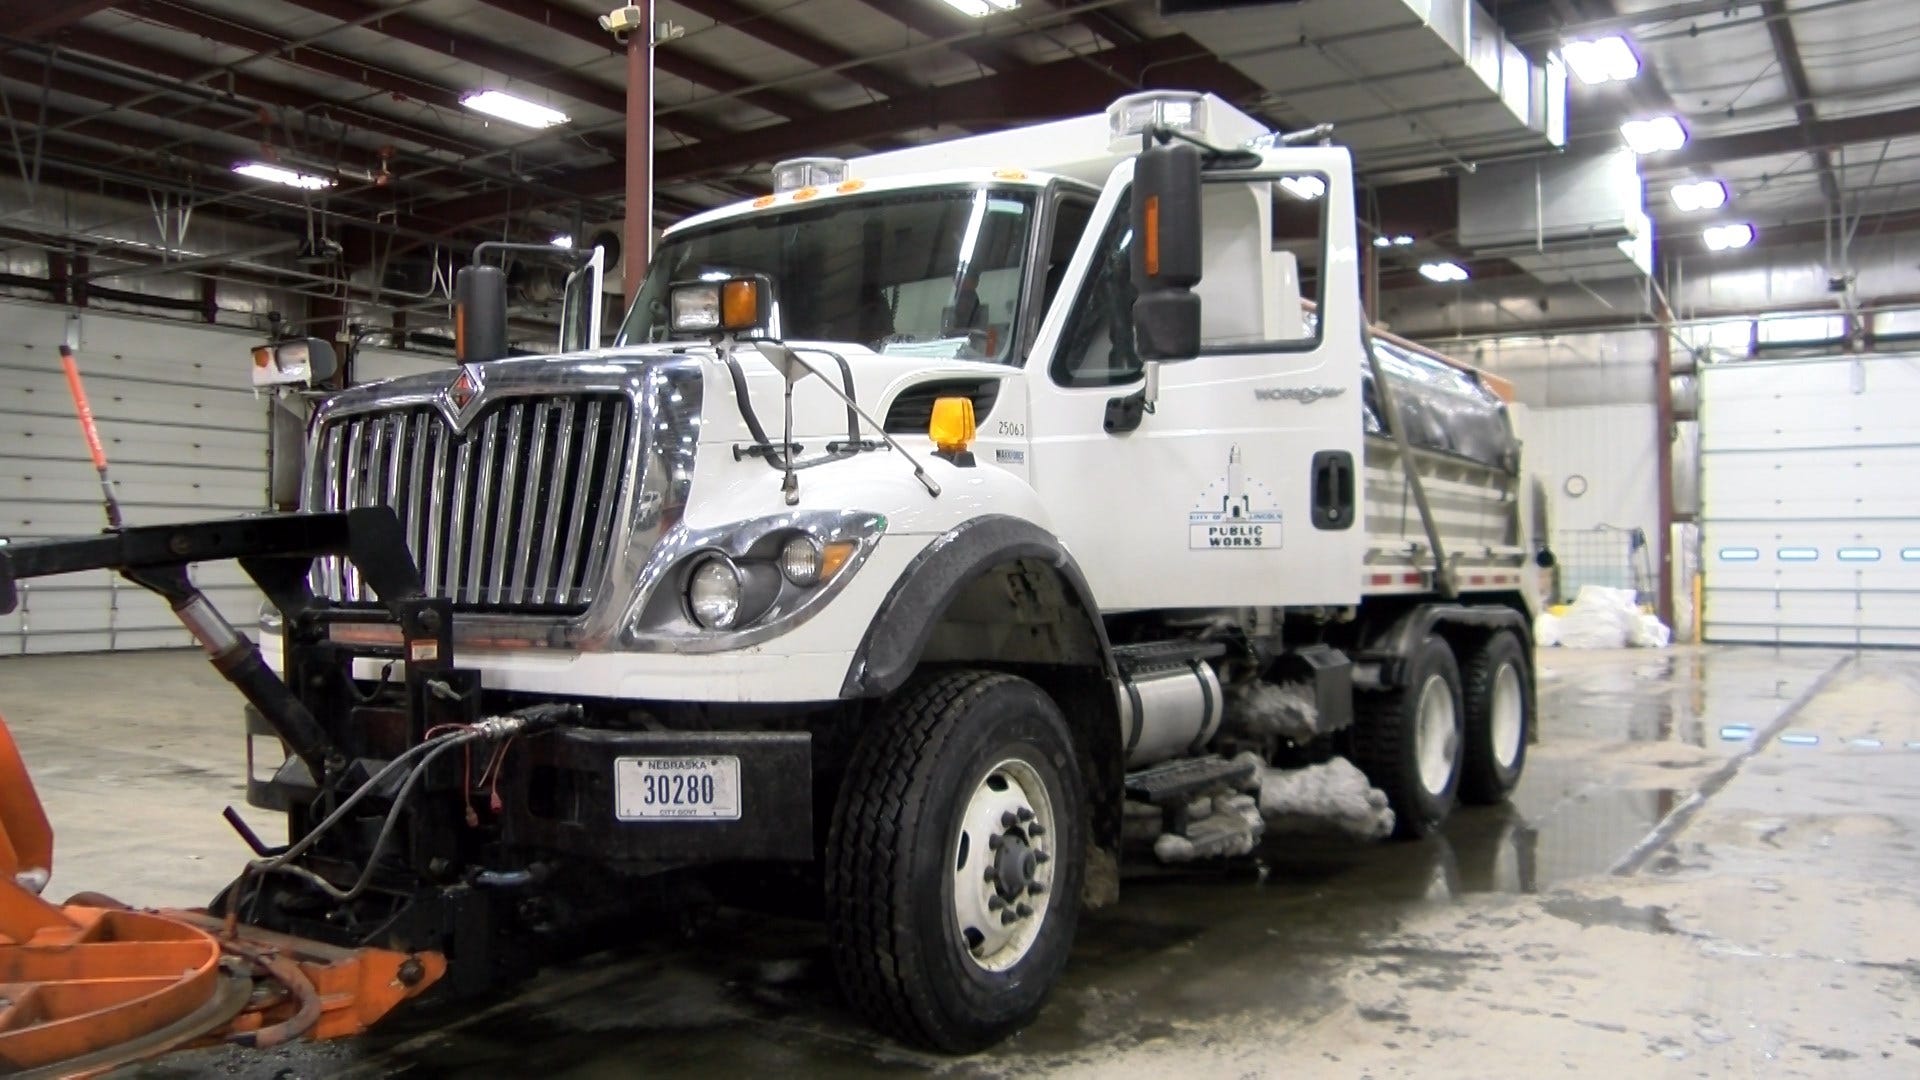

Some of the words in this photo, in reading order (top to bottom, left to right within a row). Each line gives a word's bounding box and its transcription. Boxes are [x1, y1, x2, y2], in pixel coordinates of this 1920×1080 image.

[998, 421, 1025, 436] 25063
[1208, 525, 1263, 536] PUBLIC
[1209, 537, 1262, 546] WORKS
[648, 760, 707, 770] NEBRASKA
[643, 774, 714, 805] 30280
